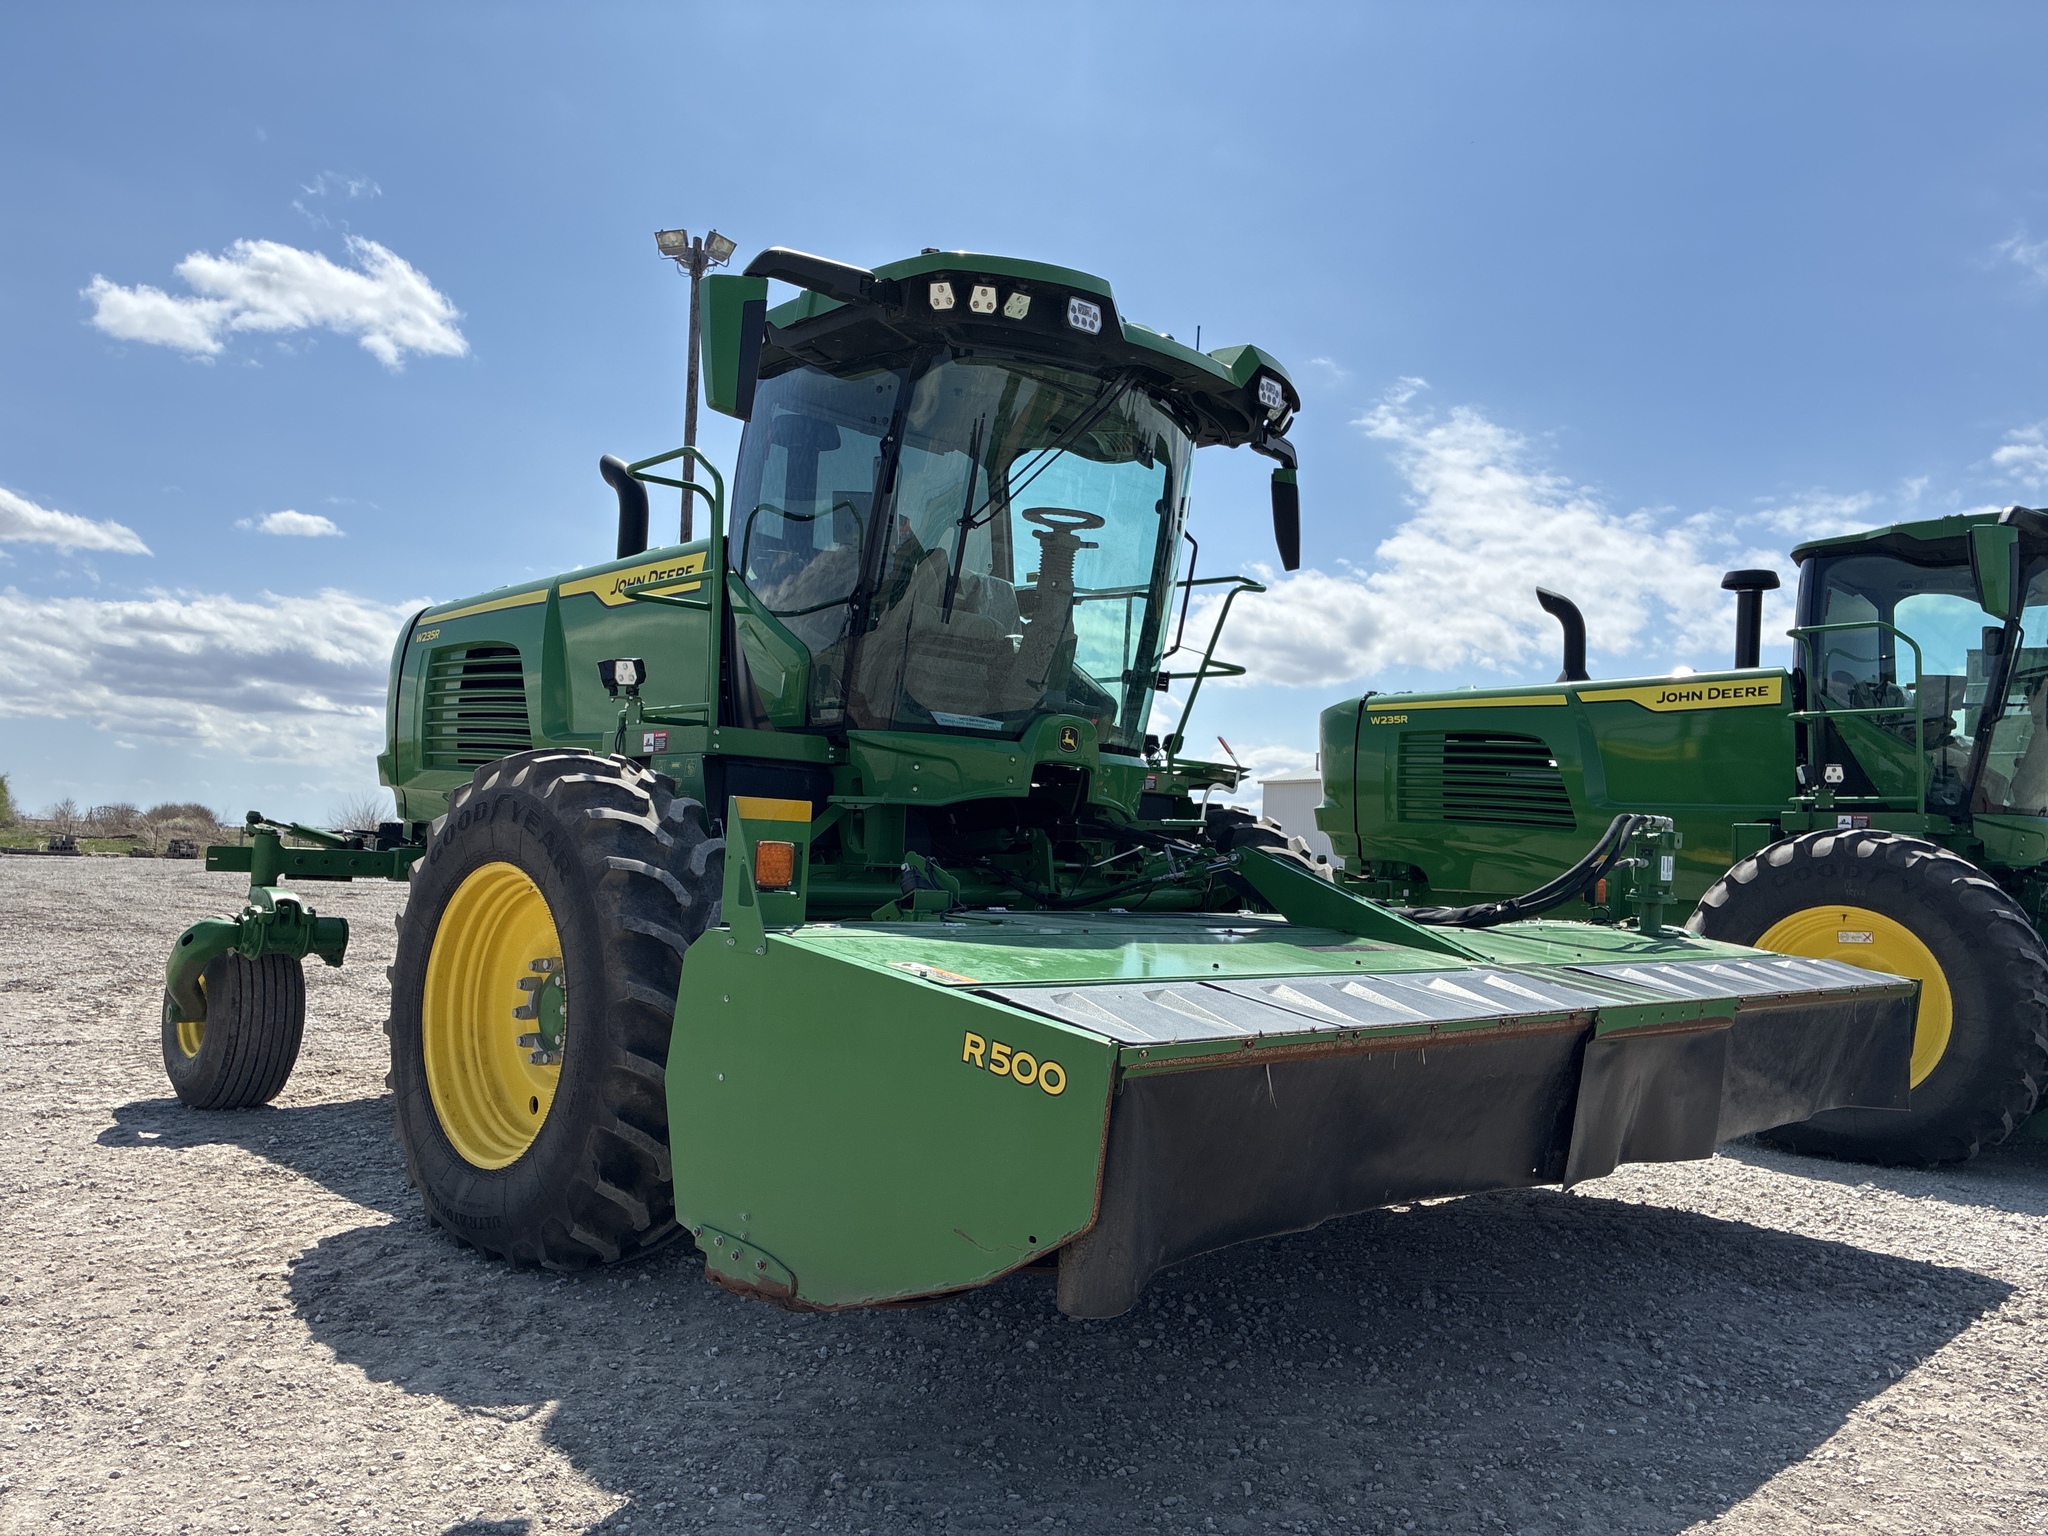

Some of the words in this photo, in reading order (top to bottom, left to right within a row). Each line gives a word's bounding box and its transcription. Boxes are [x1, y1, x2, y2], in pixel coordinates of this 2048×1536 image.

[610, 574, 646, 595] JOHN
[416, 628, 441, 643] W235R
[1656, 690, 1703, 704] JOHN
[1707, 685, 1769, 700] DEERE
[1370, 714, 1409, 725] W235R
[430, 793, 573, 885] GOODYEAR
[962, 1029, 1068, 1096] R500
